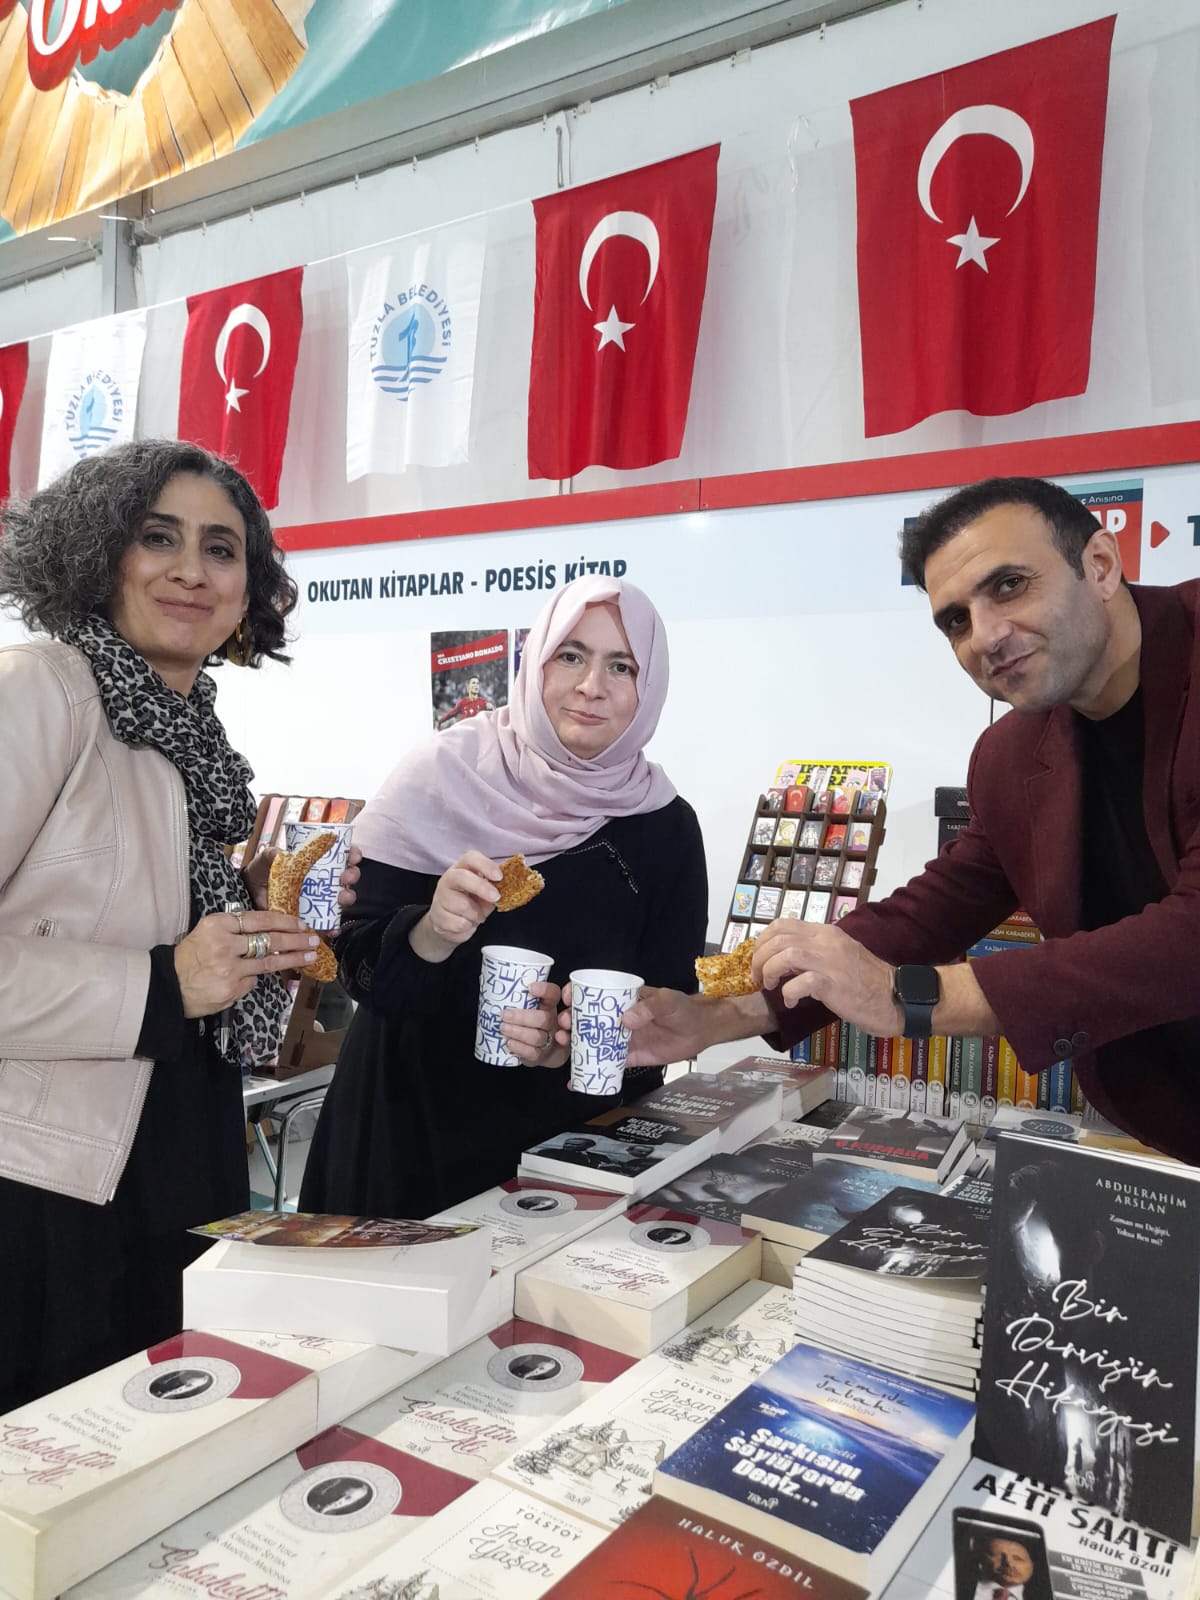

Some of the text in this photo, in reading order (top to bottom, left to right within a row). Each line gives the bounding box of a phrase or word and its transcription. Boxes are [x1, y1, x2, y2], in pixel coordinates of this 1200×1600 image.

[369, 302, 395, 361] TUZLA
[307, 577, 372, 603] OKUTAN
[379, 569, 464, 599] KİTAPLAR
[485, 559, 556, 593] POESİS
[1095, 1177, 1188, 1209] ABDULRAHİM
[1114, 1194, 1167, 1215] ARSLAN
[673, 1378, 731, 1404] TOLSTOY
[482, 1522, 563, 1559] İnsan
[515, 1507, 582, 1541] TOLSTOY
[677, 1517, 746, 1557] HALUK
[468, 1536, 555, 1578] Yaşar
[1079, 1535, 1124, 1561] Haluk
